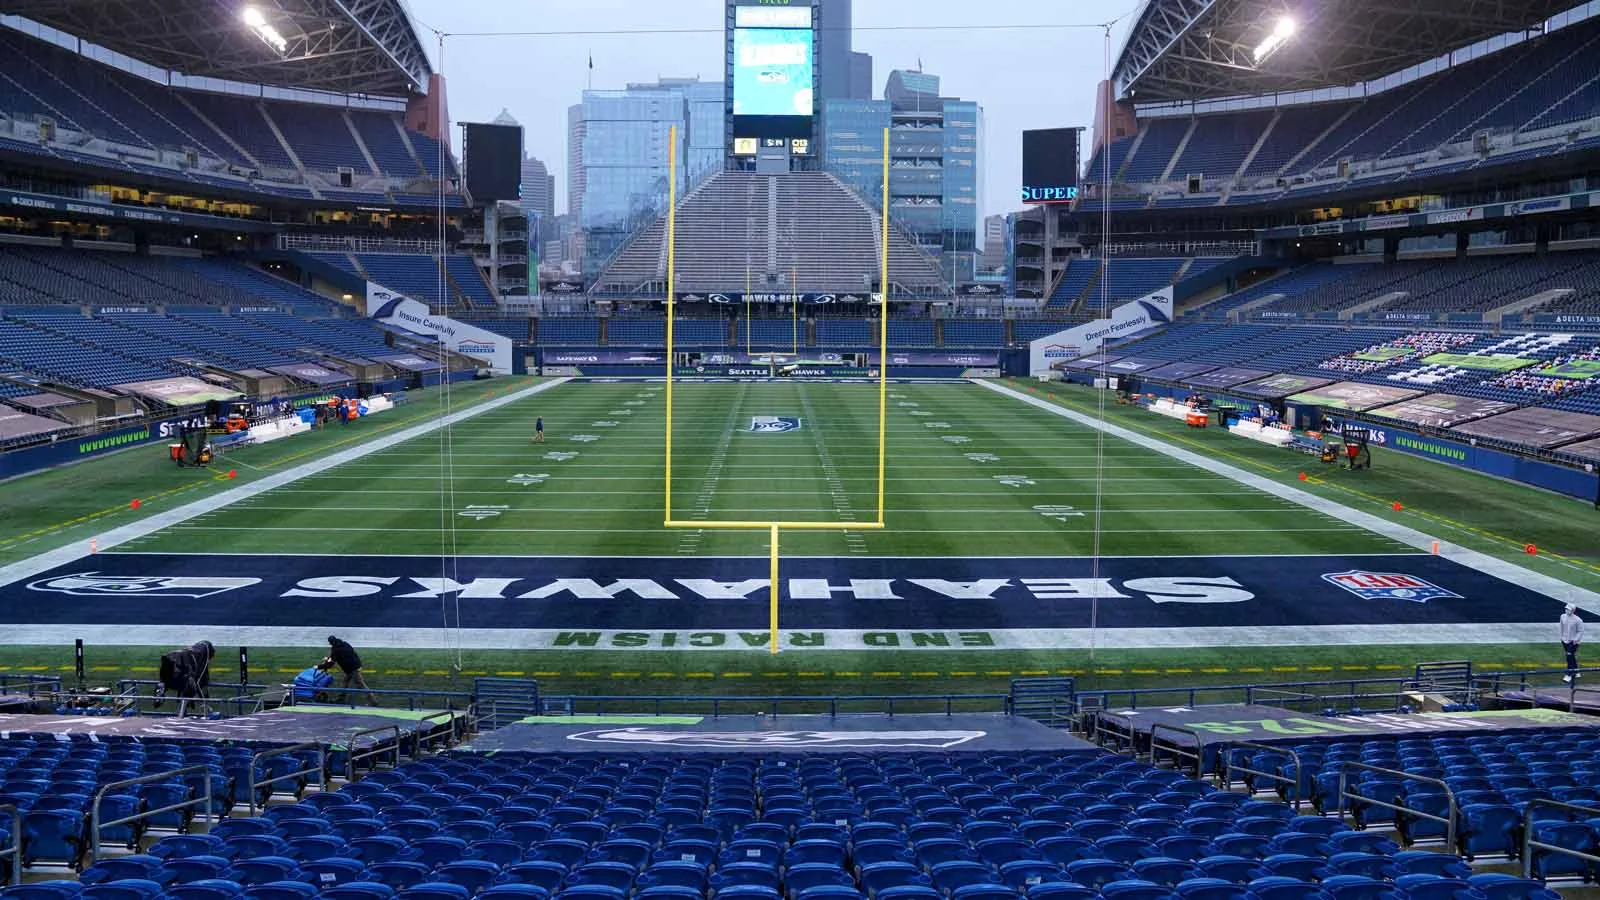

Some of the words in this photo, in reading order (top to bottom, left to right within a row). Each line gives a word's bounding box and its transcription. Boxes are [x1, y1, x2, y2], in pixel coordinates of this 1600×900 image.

[1021, 186, 1079, 200] SUPER
[400, 310, 421, 324] Insure
[423, 318, 456, 337] Carefully
[1085, 327, 1110, 341] Dream
[1110, 315, 1146, 333] Fearlessly
[1334, 573, 1425, 587] NFL
[280, 575, 1255, 604] SEAHAWKS
[551, 631, 825, 647] RACISM
[864, 631, 996, 647] END
